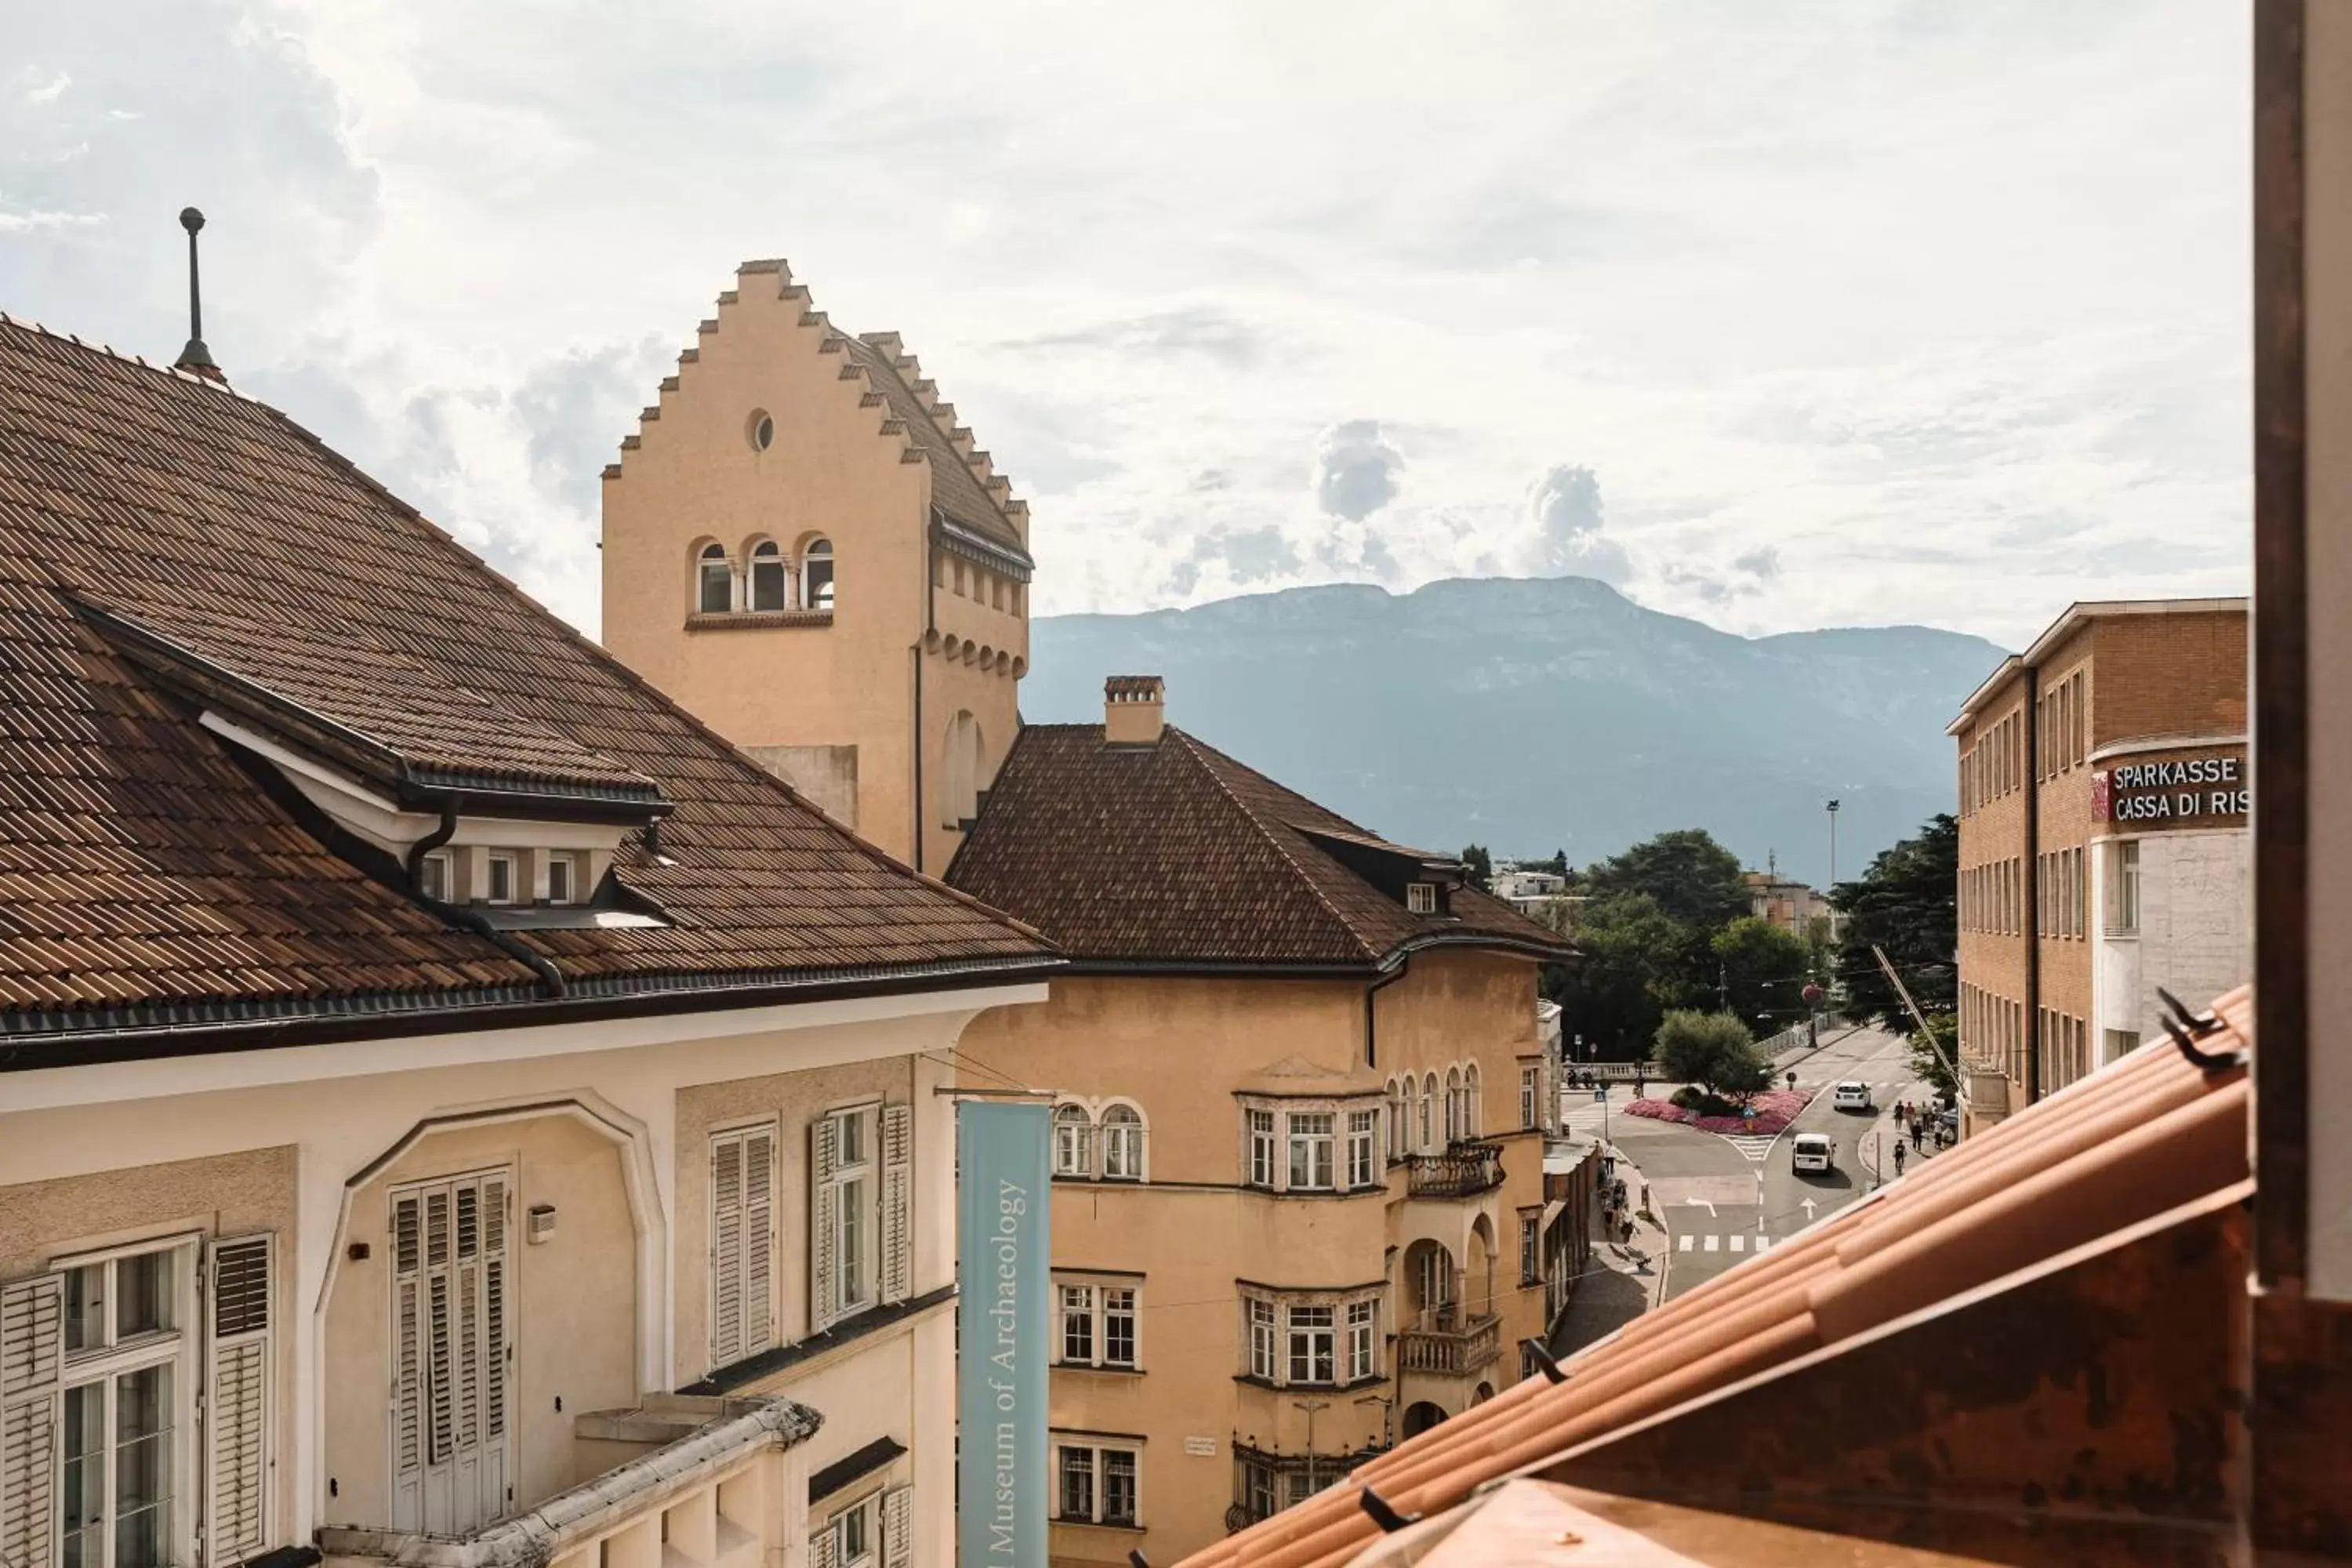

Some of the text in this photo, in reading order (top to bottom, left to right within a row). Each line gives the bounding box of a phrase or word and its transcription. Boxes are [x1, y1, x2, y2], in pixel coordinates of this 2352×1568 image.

[2114, 758, 2238, 789] SPARKASSE
[2117, 795, 2170, 820] CASSA
[2179, 793, 2200, 815] DI
[989, 1178, 1026, 1372] Archaeology
[989, 1377, 1015, 1411] of
[989, 1423, 1014, 1555] Museum
